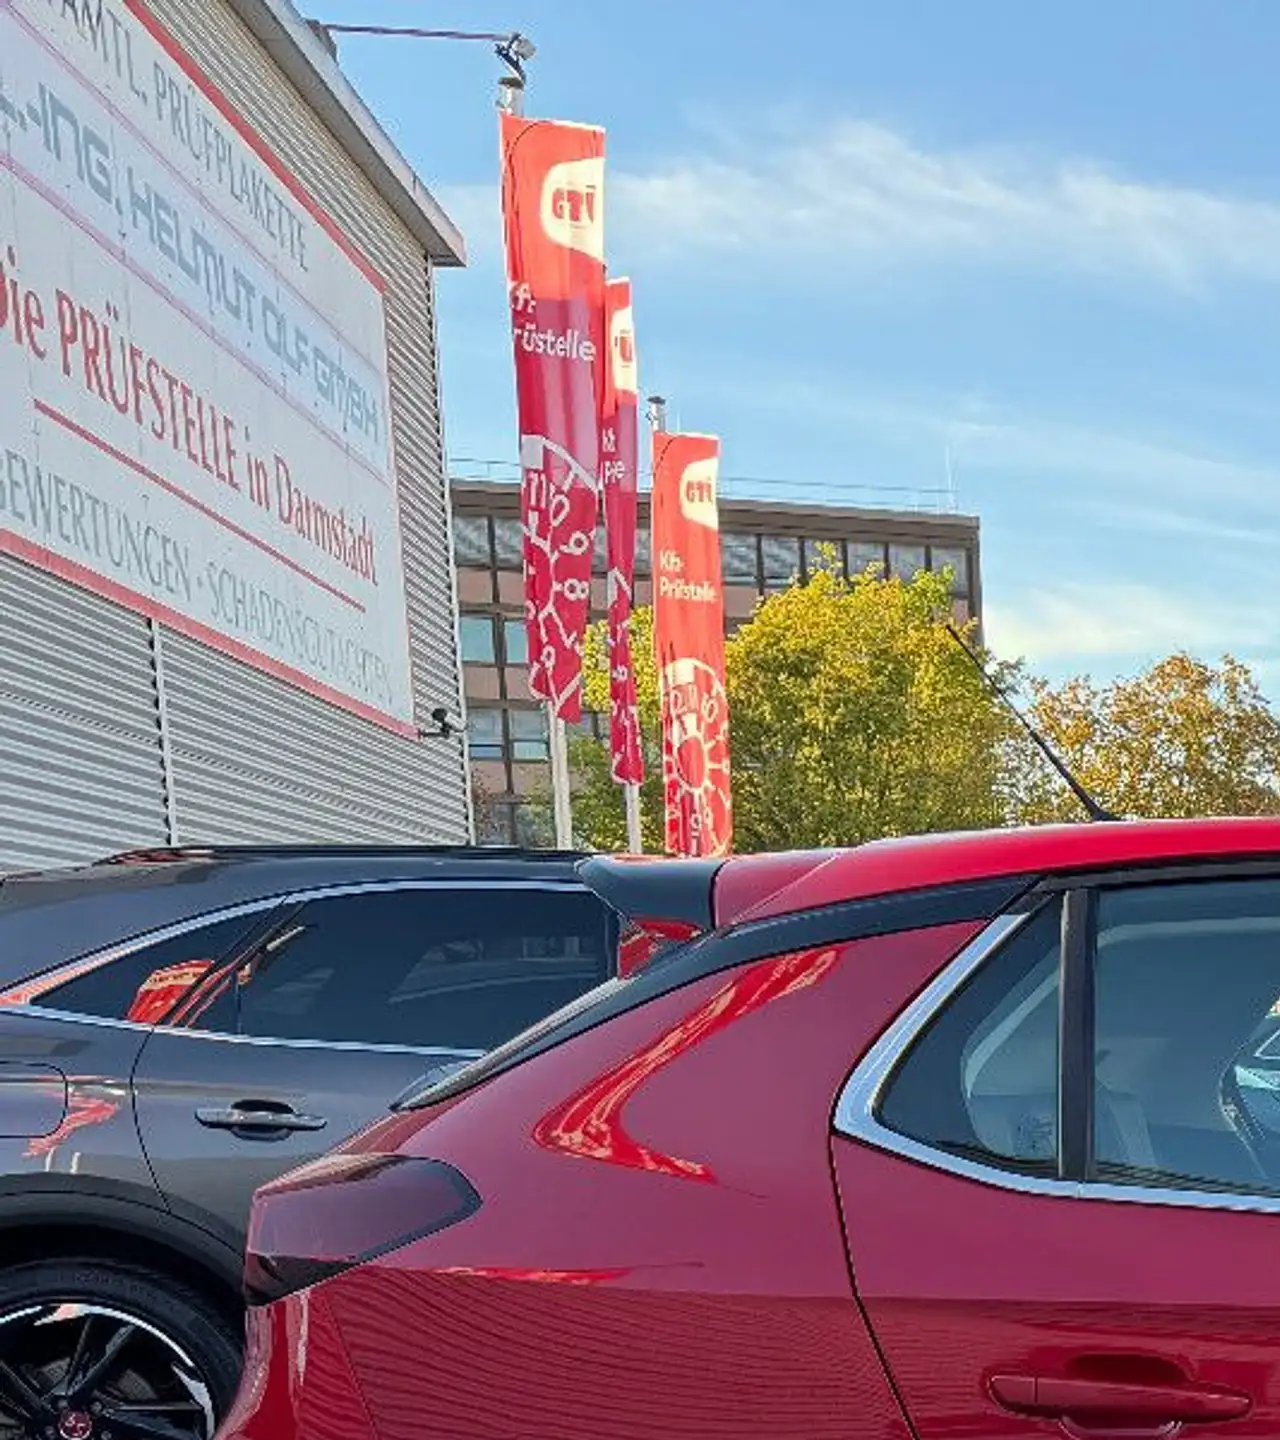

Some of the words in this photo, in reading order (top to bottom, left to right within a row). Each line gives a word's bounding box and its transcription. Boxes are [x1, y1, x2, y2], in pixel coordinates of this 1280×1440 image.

[126, 165, 257, 336] HELMUT
[153, 60, 308, 272] PRÜFPLAKETTE
[0, 446, 192, 601] EWERTUNGEN
[55, 288, 241, 493] PRÜFSTELLE
[244, 426, 270, 512] in
[274, 453, 378, 587] Darmstadt
